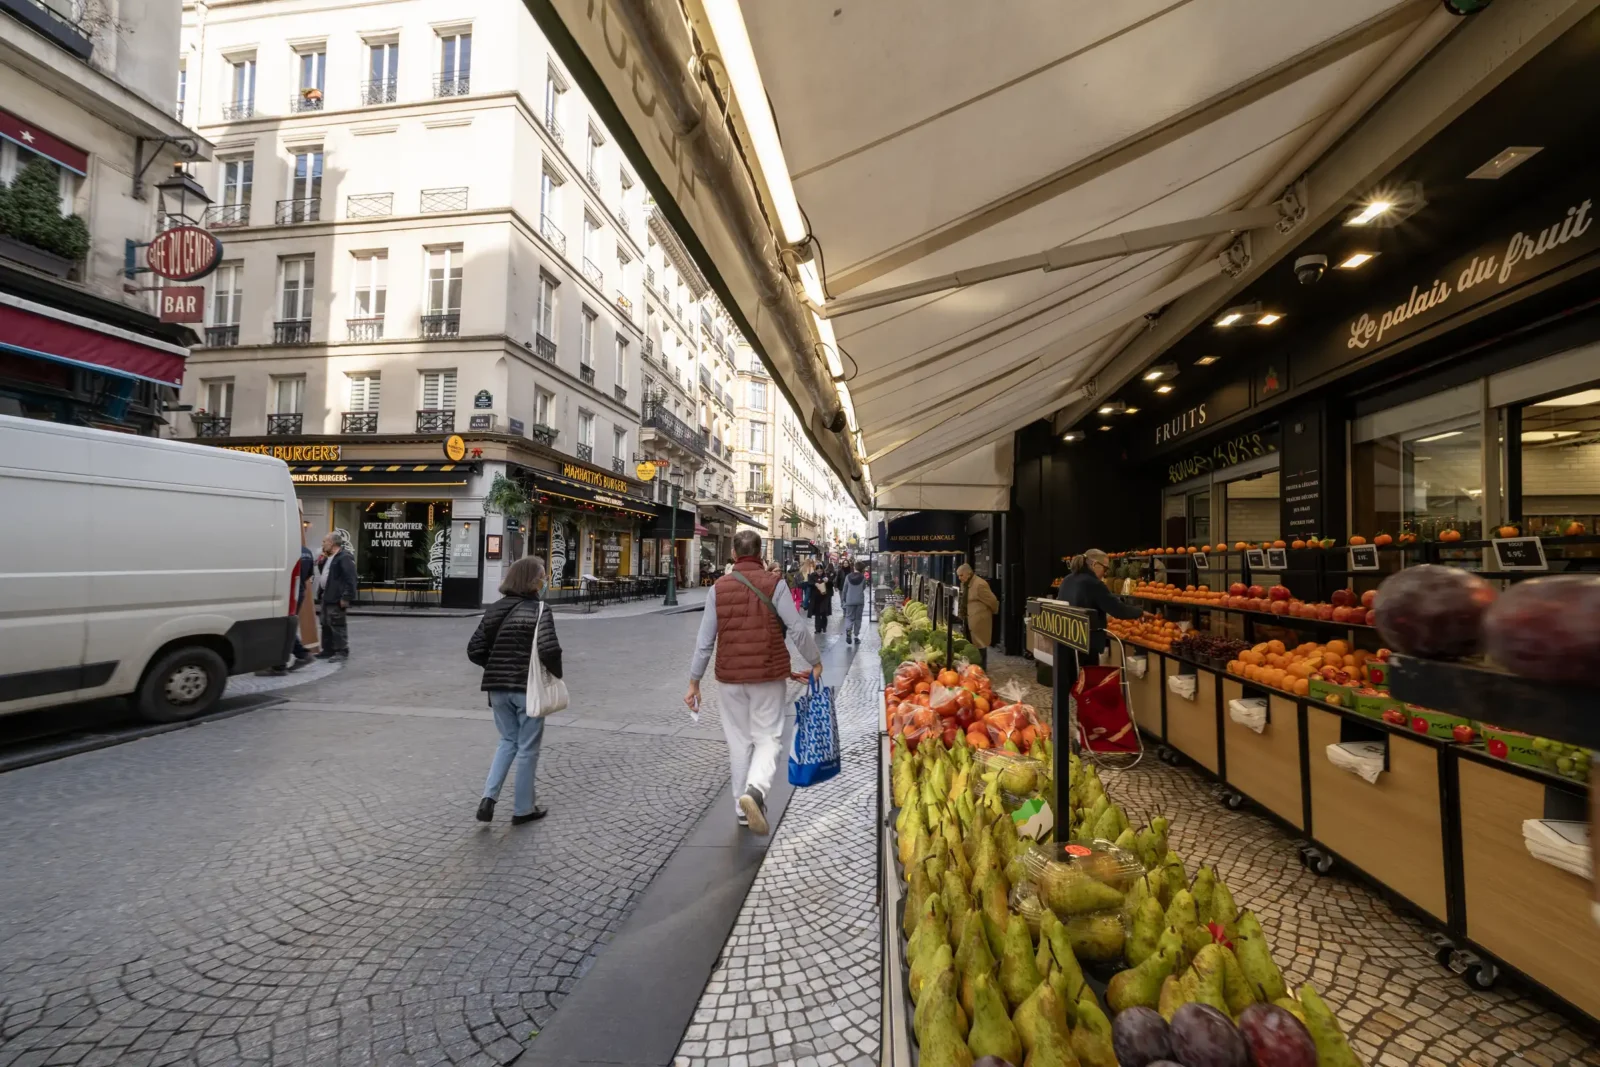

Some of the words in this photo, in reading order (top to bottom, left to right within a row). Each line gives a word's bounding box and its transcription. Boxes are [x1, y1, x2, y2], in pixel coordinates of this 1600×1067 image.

[169, 231, 181, 275] DU
[183, 230, 214, 274] CENTRE
[1347, 313, 1378, 349] Le
[1376, 279, 1453, 343] palais
[1457, 256, 1498, 292] du
[1497, 198, 1593, 284] fruit
[164, 295, 197, 313] BAR
[1155, 403, 1206, 445] FRUITS
[273, 445, 340, 460] BURGERS
[318, 474, 348, 482] BURGERS
[603, 475, 628, 493] BURGERS
[363, 522, 383, 530] VENEZ
[383, 522, 423, 530] RENCONTRER
[1030, 610, 1089, 646] PROMOTION
